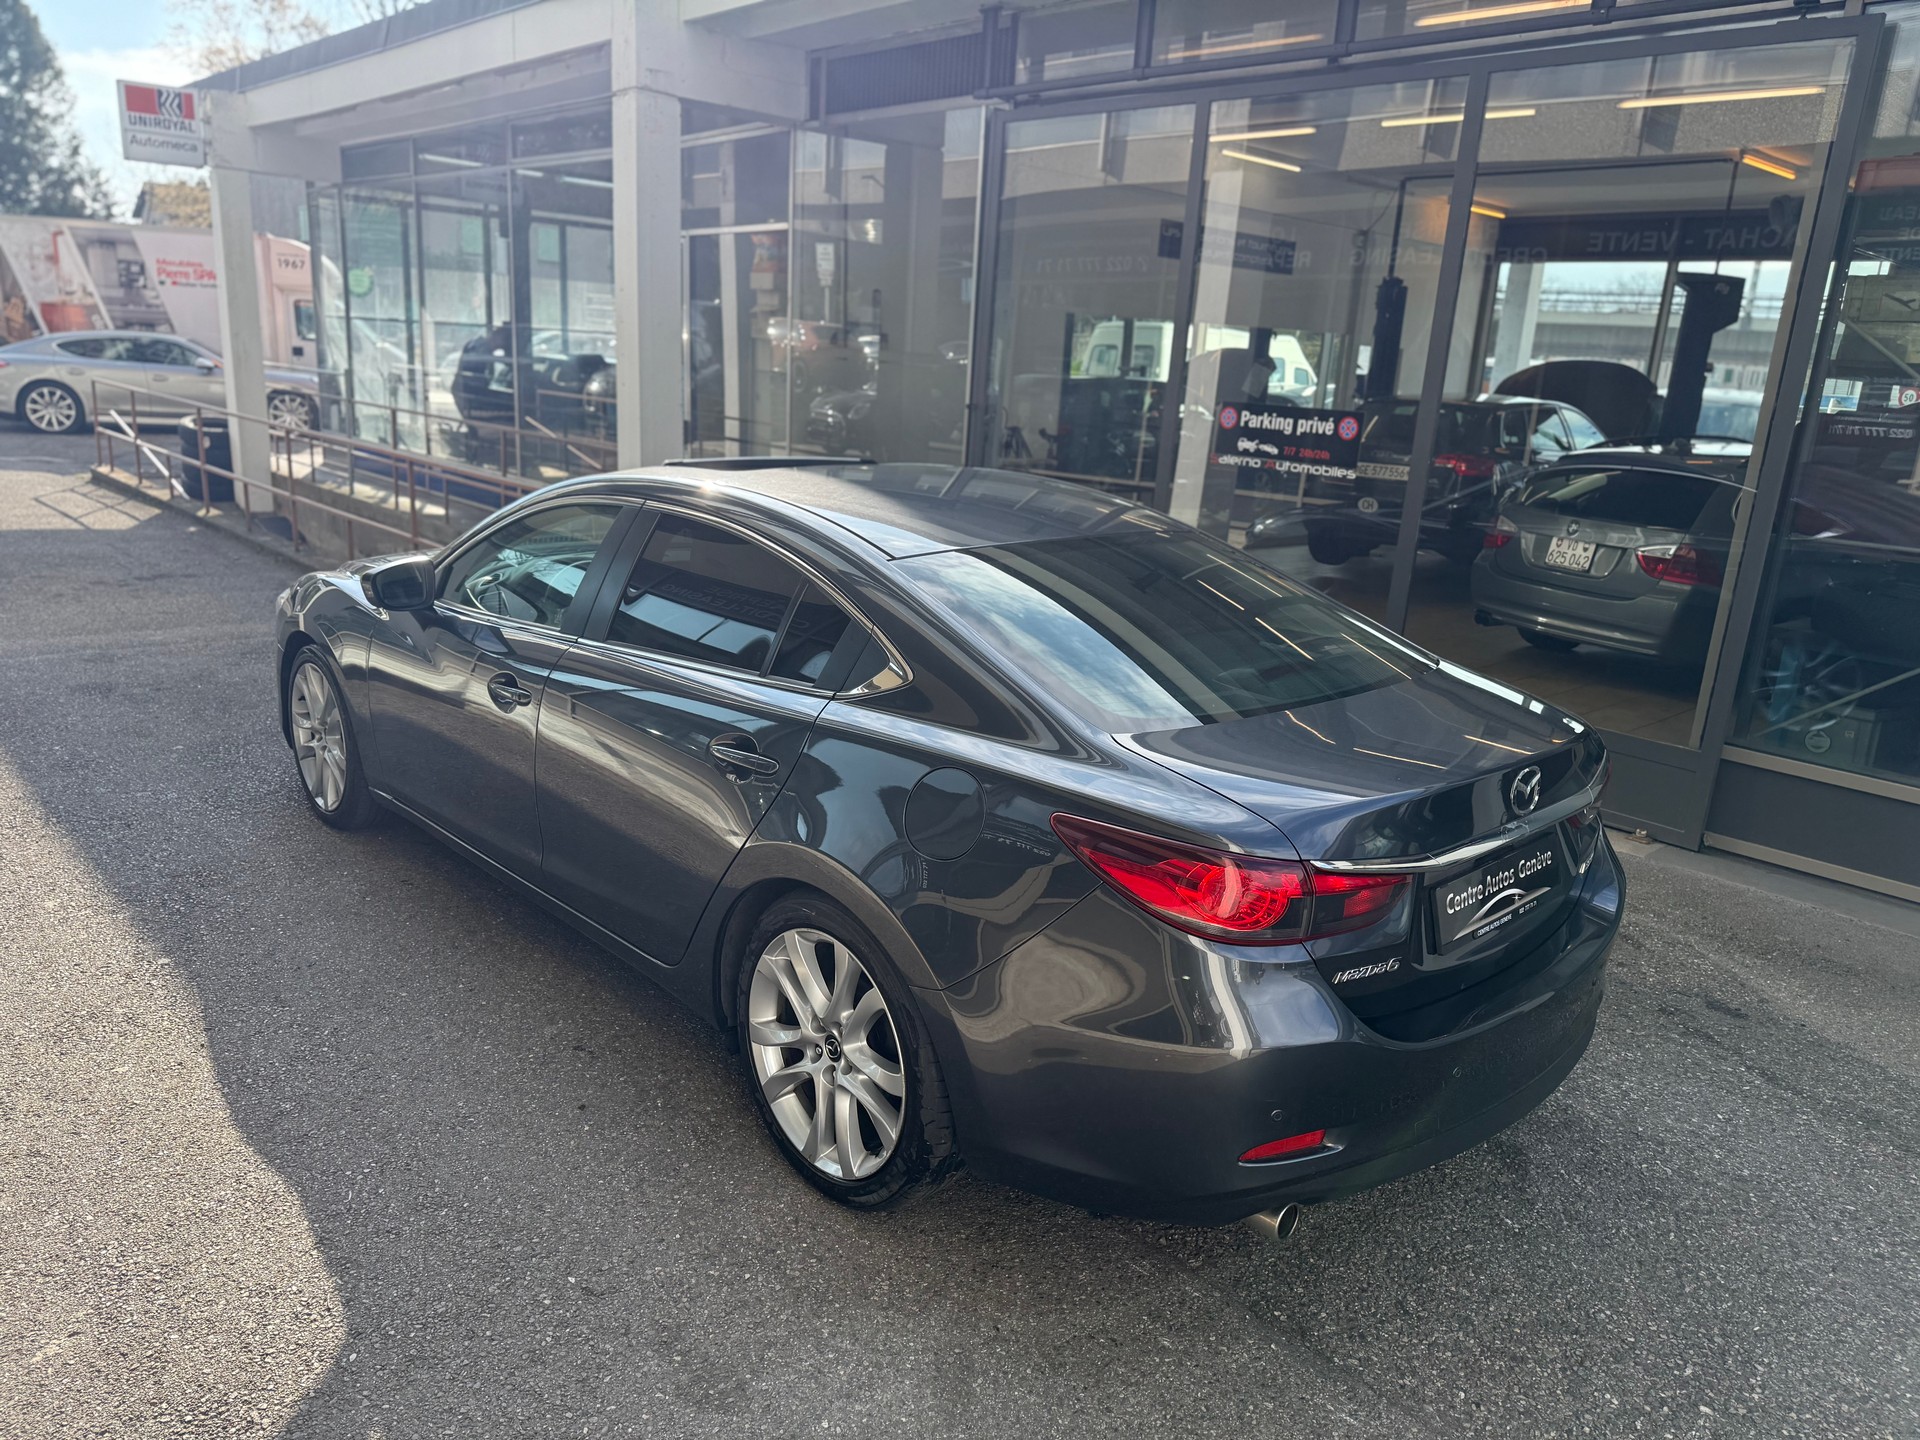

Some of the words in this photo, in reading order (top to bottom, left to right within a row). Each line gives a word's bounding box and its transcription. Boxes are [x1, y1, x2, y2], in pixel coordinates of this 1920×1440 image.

[128, 113, 196, 133] UNIROYAL
[130, 134, 198, 153] Automeca
[277, 258, 305, 269] 1967
[1240, 410, 1293, 435] Parking
[1296, 416, 1335, 436] privé
[1210, 453, 1261, 469] Salerno
[1264, 460, 1357, 480] Automobiles
[1362, 499, 1374, 511] CH
[1548, 549, 1568, 565] 625
[1568, 553, 1590, 569] 042
[1446, 884, 1484, 915] Centre
[1485, 868, 1516, 897] Autos
[1518, 851, 1552, 879] Genève
